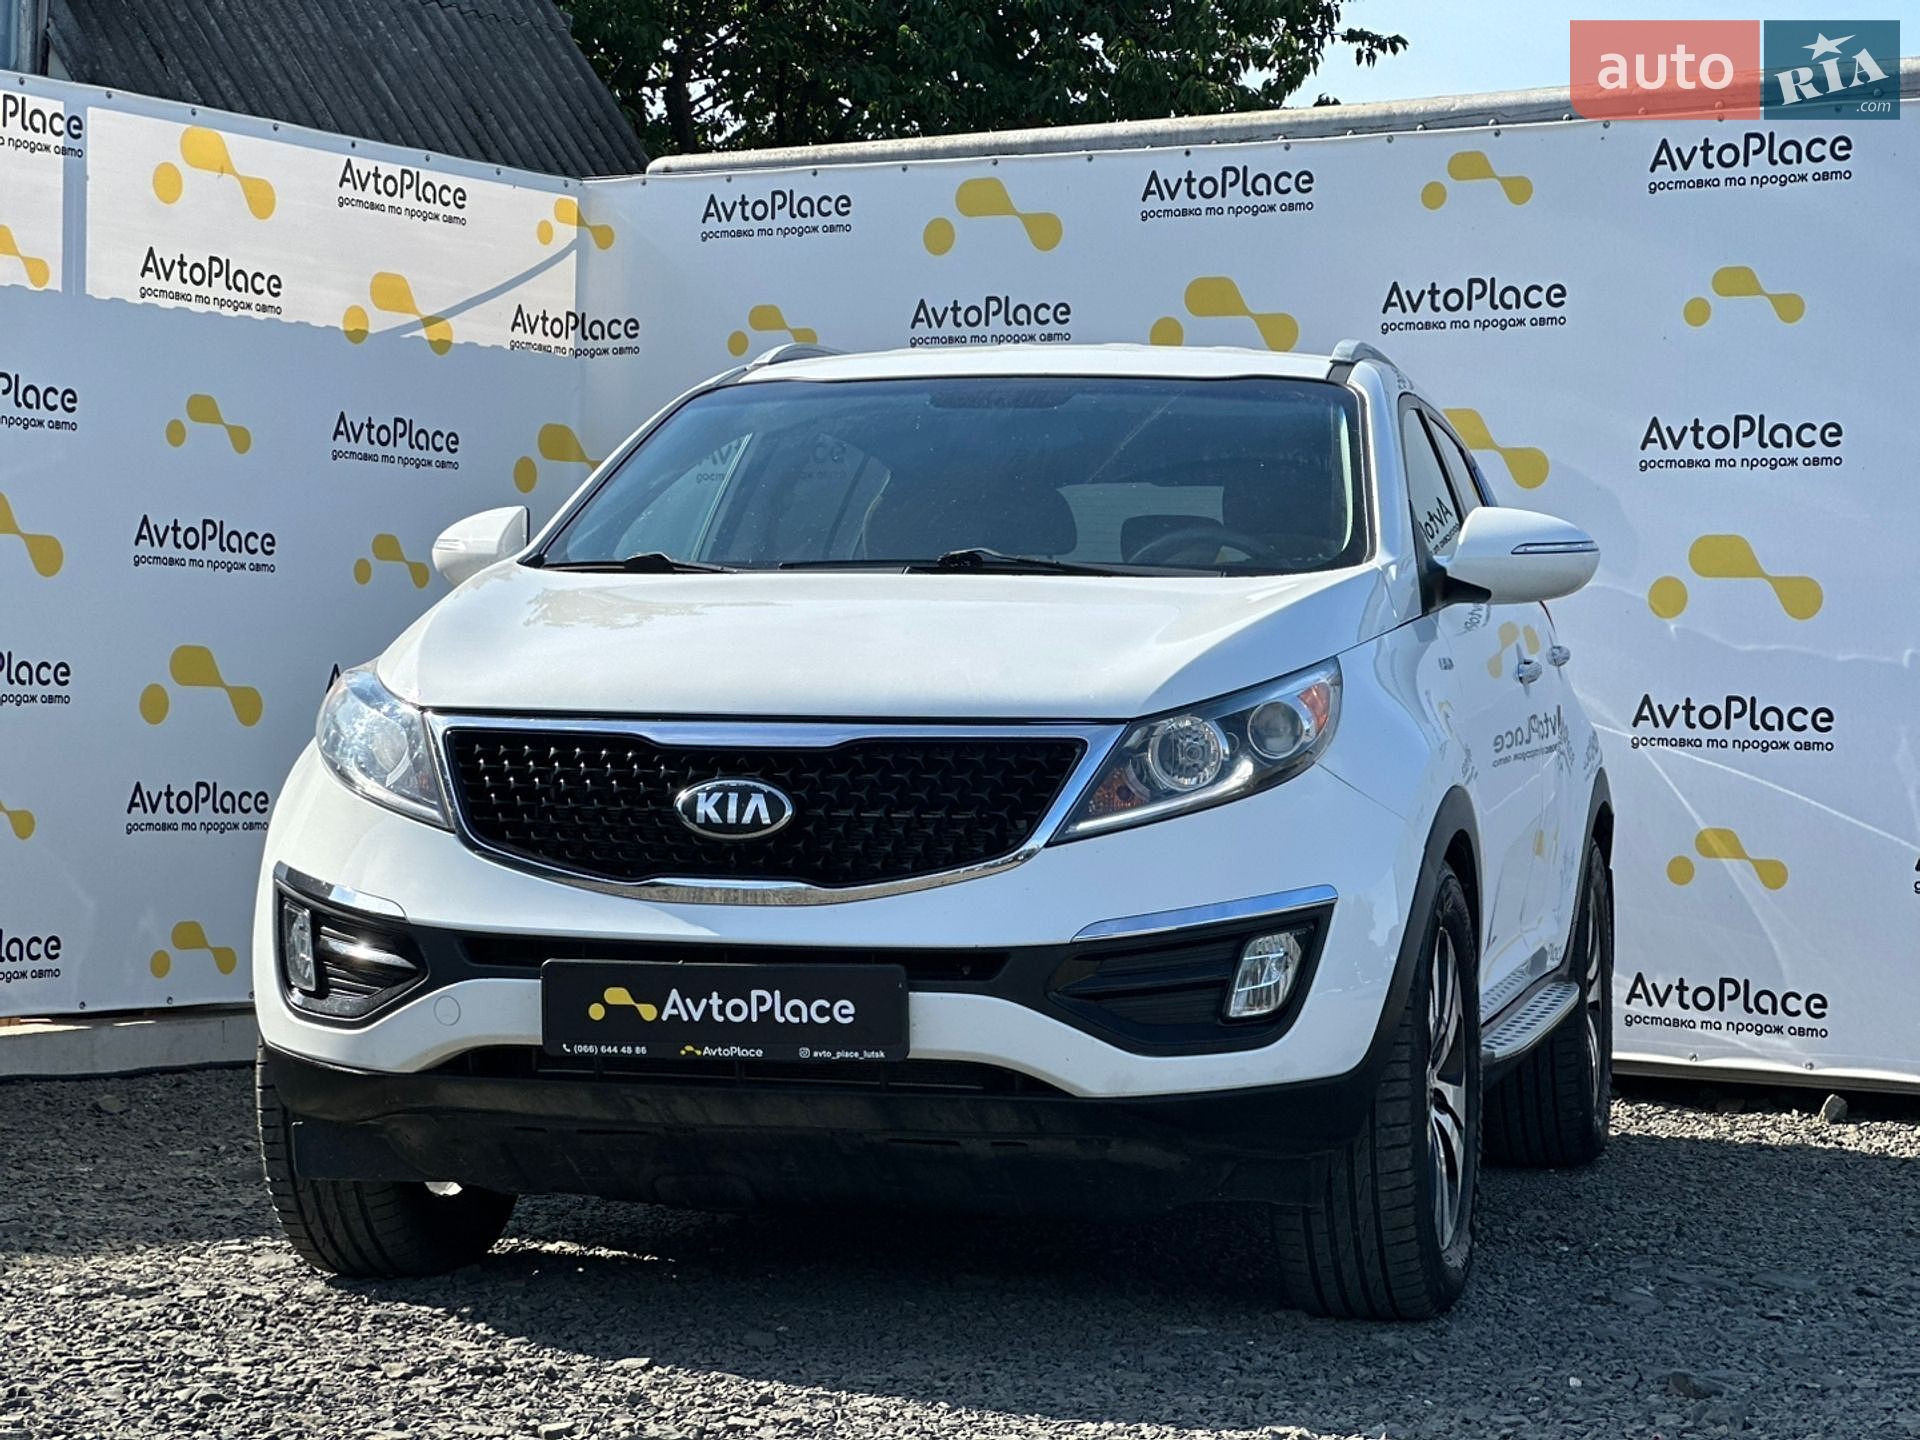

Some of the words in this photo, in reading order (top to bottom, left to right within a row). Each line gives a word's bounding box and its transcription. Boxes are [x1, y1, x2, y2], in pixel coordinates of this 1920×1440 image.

[2, 93, 84, 140] Place
[1649, 130, 1854, 174] AvtoPlace
[339, 158, 467, 211] AvtoPlace
[1141, 165, 1315, 202] AvtoPlace
[701, 189, 853, 226] AvtoPlace
[140, 246, 283, 299] AvtoPlace
[910, 295, 1072, 329] AvtoPlace
[1382, 277, 1568, 315] AvtoPlace
[511, 304, 640, 341] AvtoPlace
[332, 411, 460, 456] AvtoPlace
[1640, 414, 1844, 452] AvtoPlace
[134, 514, 276, 557] AvtoPlace
[1632, 694, 1835, 734] AvtoPlace
[127, 781, 270, 815] AvtoPlace
[695, 791, 772, 825] KIA
[660, 988, 856, 1025] AvtoPlace
[1624, 972, 1829, 1021] AvtoPlace
[702, 1046, 763, 1058] AvtoPlace
